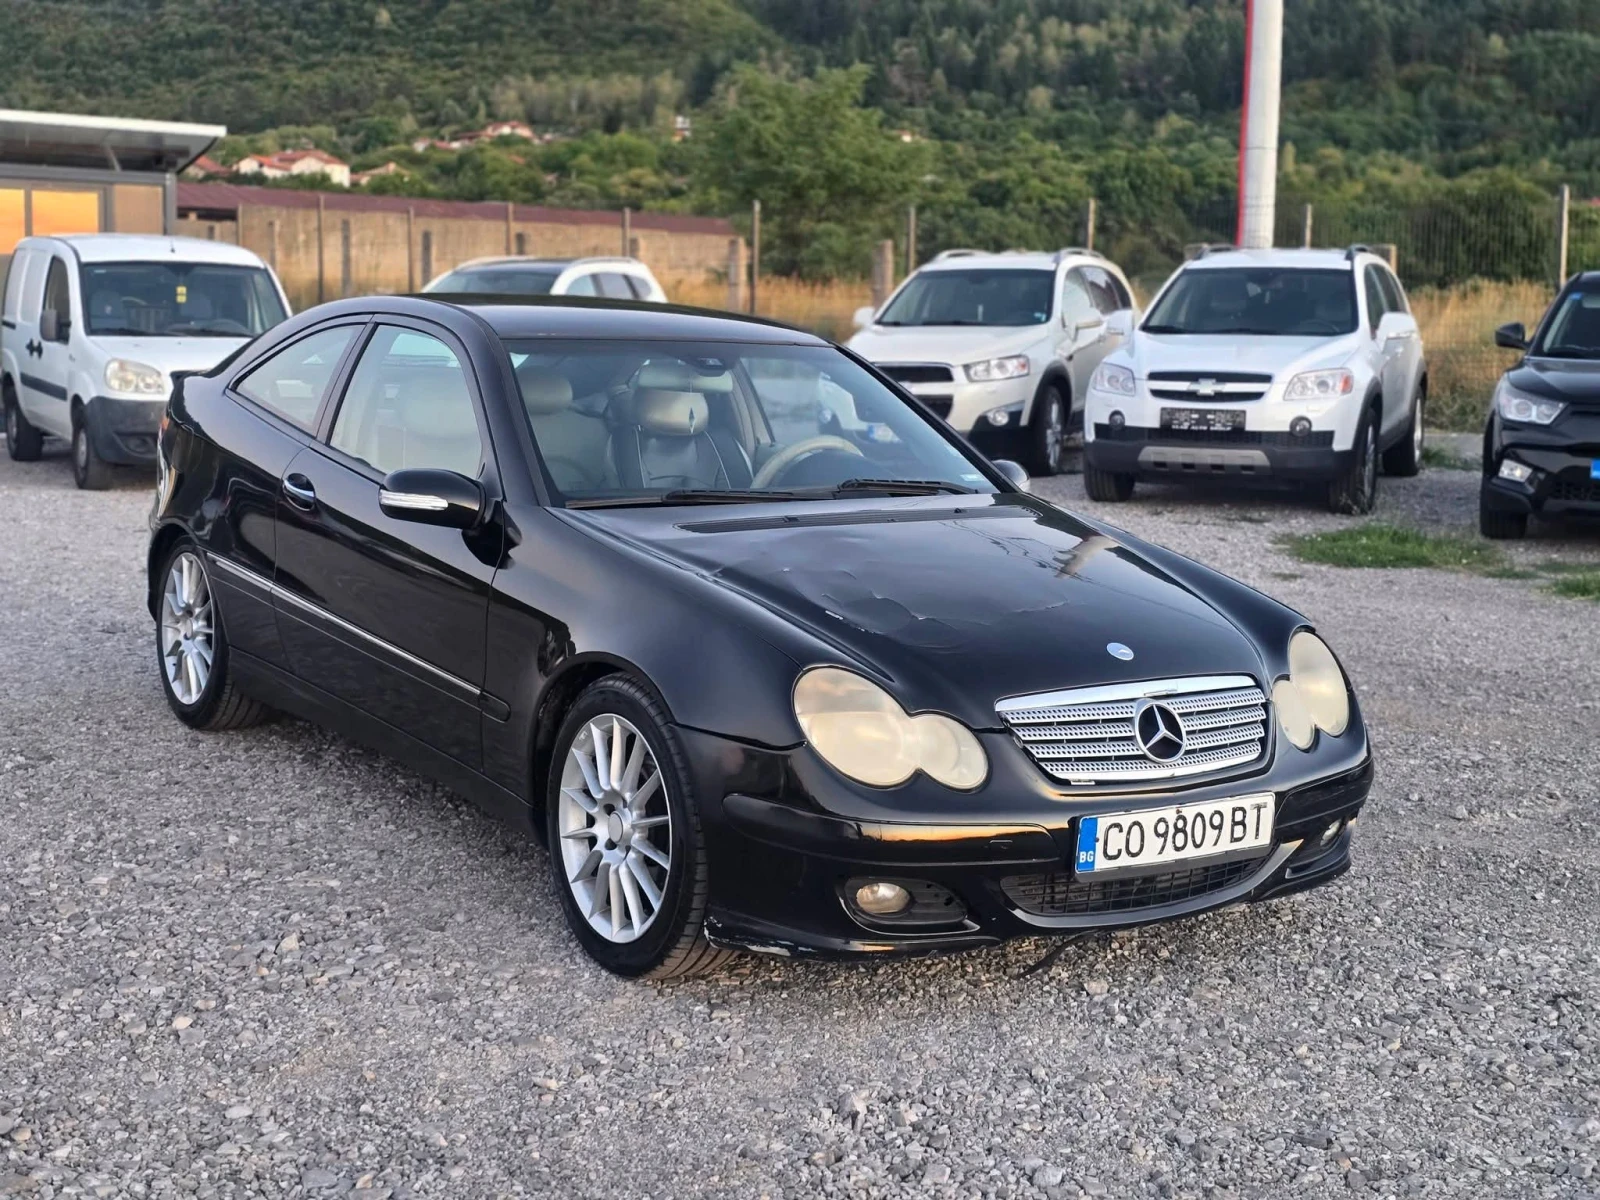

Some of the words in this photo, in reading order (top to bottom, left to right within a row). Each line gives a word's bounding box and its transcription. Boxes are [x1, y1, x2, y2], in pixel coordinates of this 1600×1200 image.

[1102, 820, 1145, 861] CO
[1153, 810, 1225, 856] 9809
[1079, 851, 1095, 863] BG
